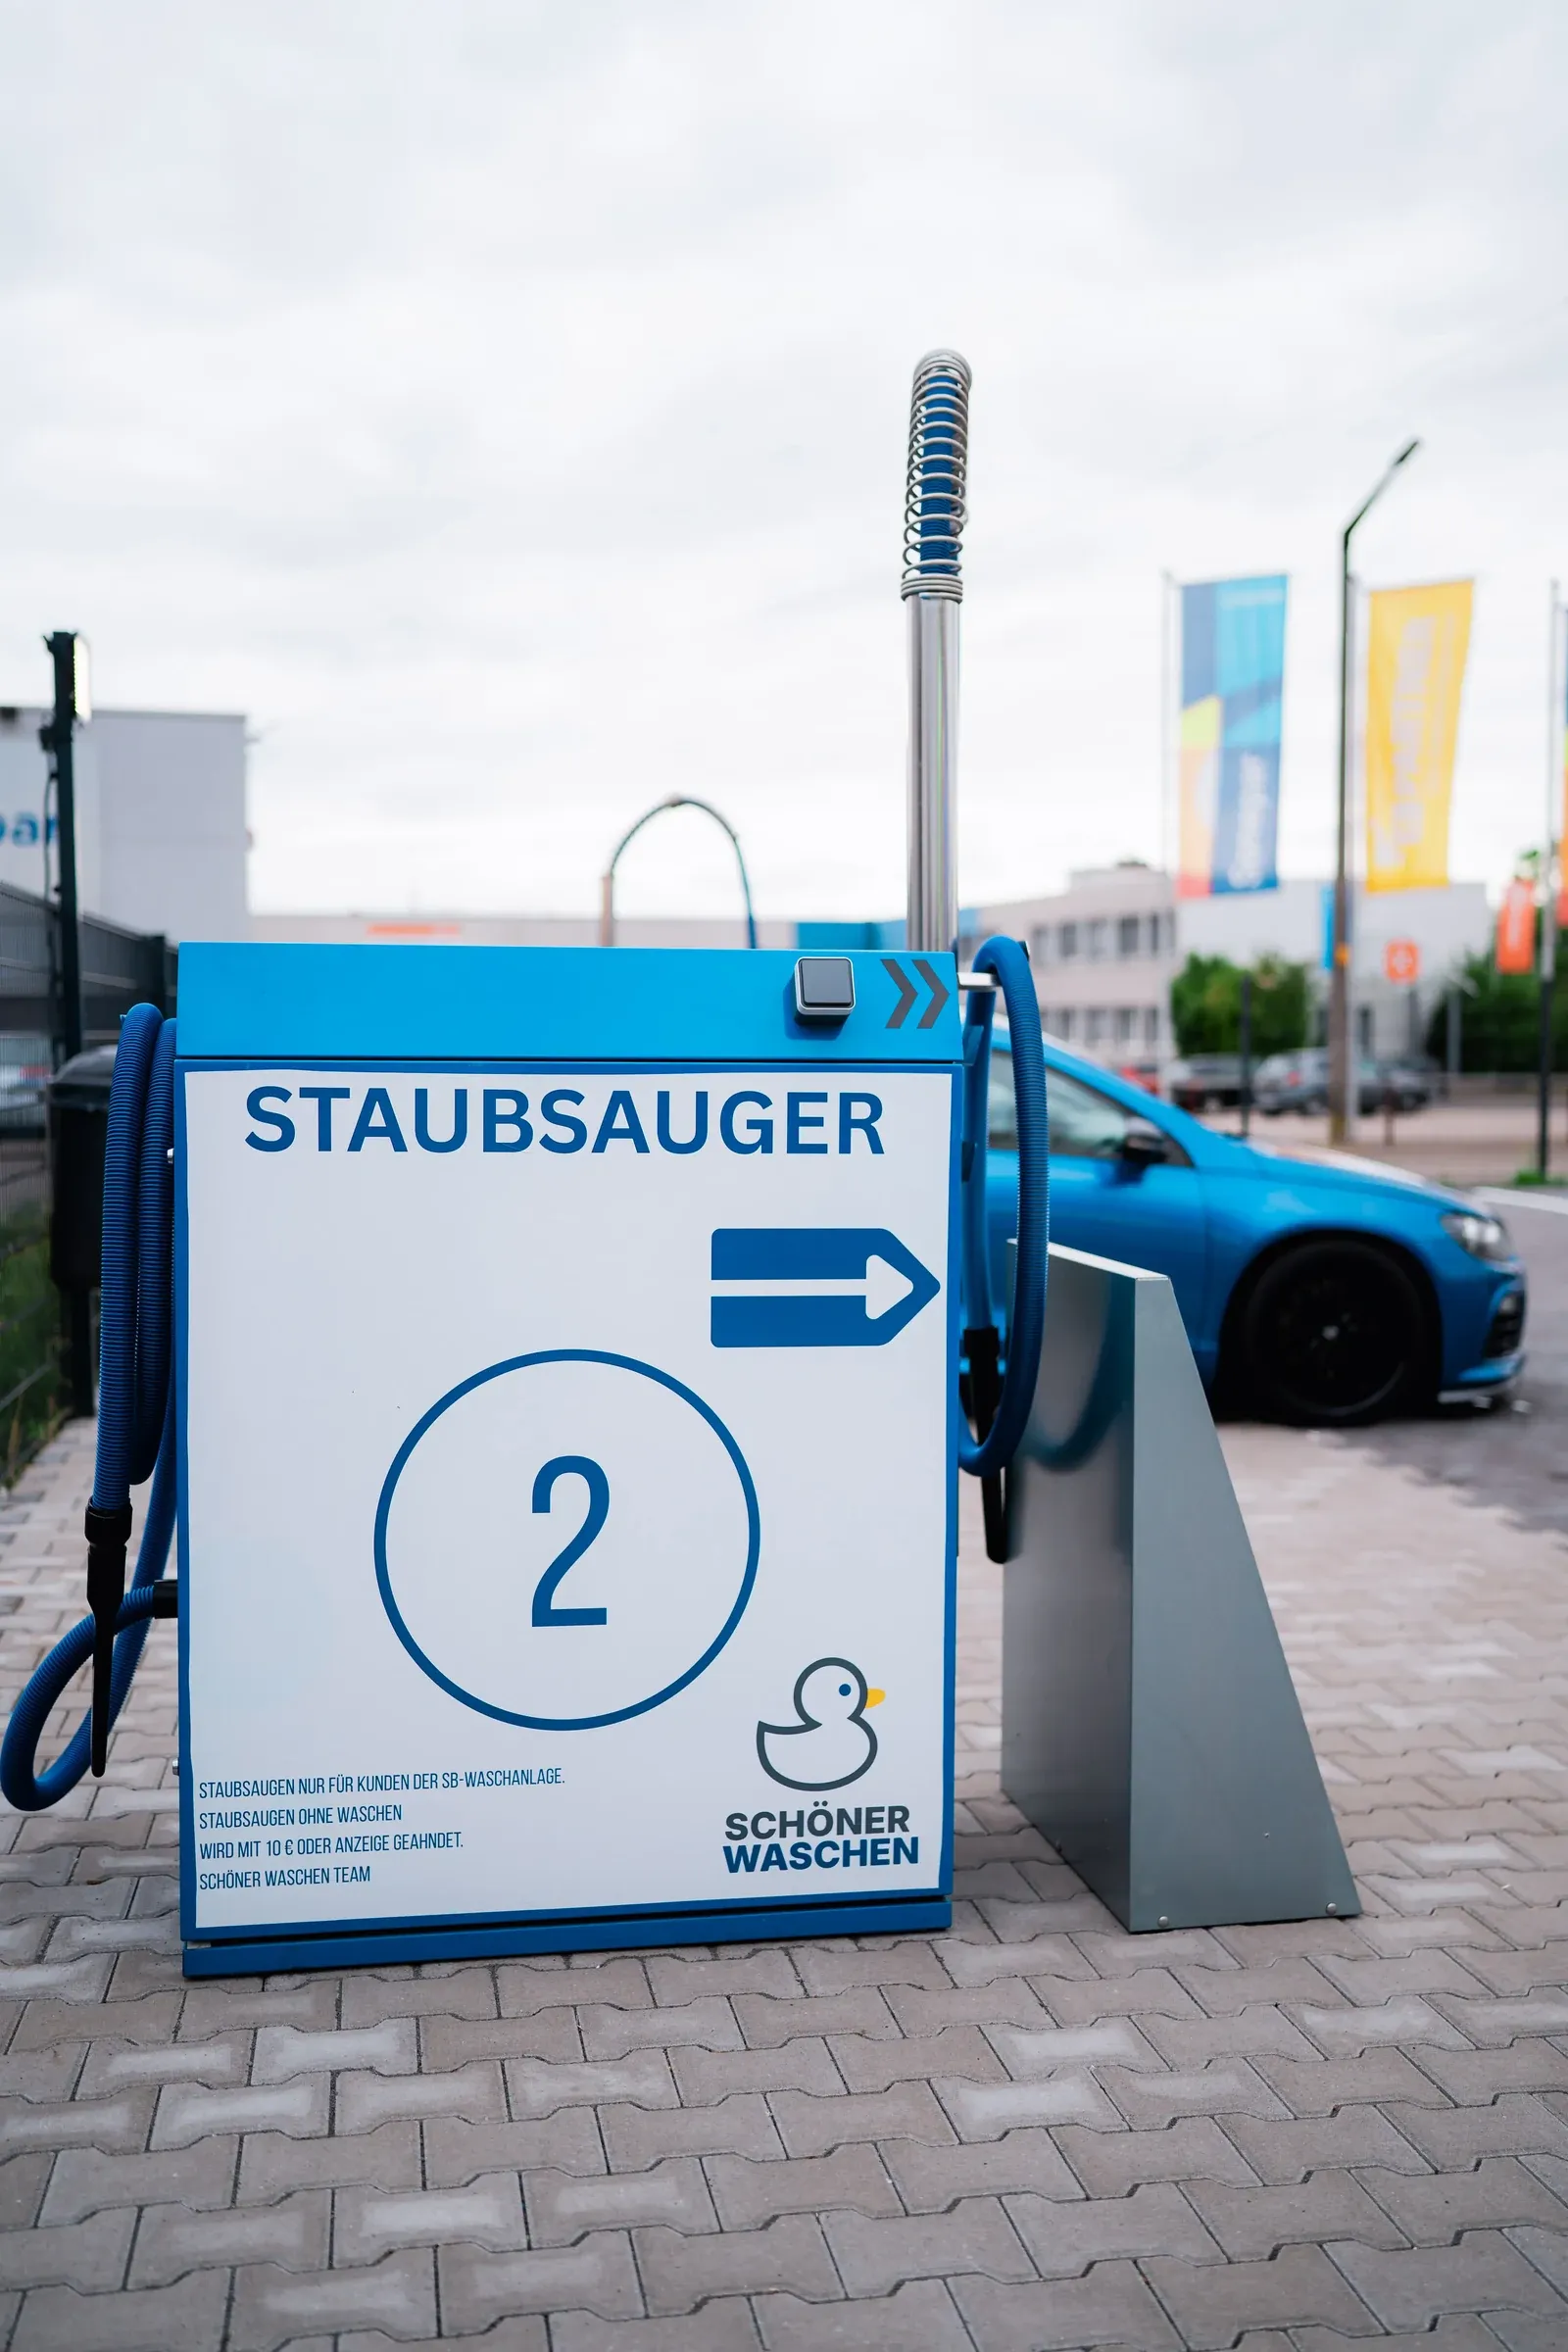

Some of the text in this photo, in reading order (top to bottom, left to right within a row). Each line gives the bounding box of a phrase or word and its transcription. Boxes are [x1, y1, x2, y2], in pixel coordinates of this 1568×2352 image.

[244, 1085, 885, 1155] STAUBSAUGER
[531, 1454, 611, 1628] 2
[198, 1767, 566, 1799] STAUBSAUGEN NUR FÜR KUNDEN DER SB-WASCHANLAGE.
[199, 1803, 402, 1830] STAUBSAUGEN OHNE WASCHEN
[724, 1800, 910, 1841] SCHÖNER
[199, 1831, 463, 1860] WIRD MIT 10 € ODER ANZEIGE GEAHNDET.
[722, 1836, 919, 1874] WASCHEN
[199, 1865, 371, 1890] SCHÖNER WASCHEN TEAM
